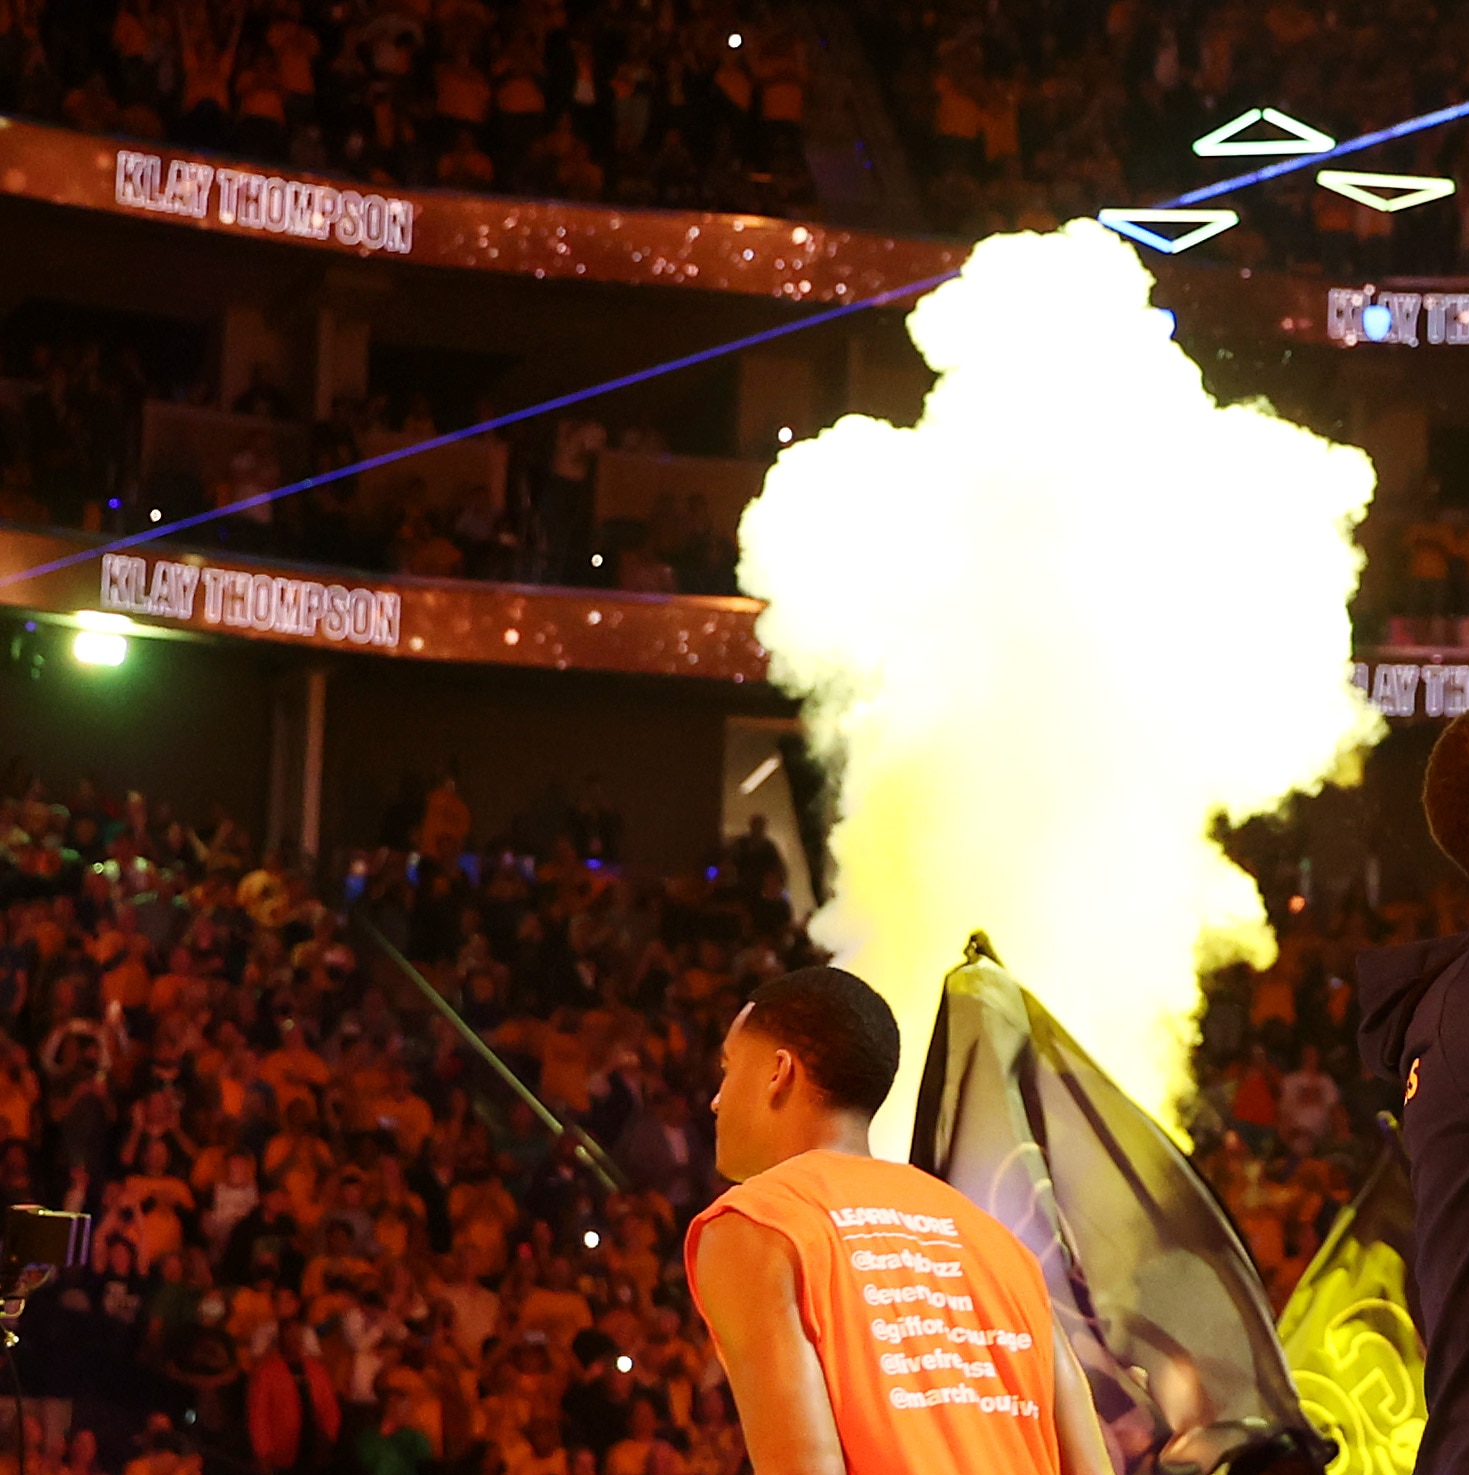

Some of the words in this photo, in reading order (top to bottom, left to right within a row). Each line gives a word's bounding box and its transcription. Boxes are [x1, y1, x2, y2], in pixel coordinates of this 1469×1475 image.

[115, 149, 214, 219] KLAY
[215, 167, 414, 254] THOMPSON
[101, 552, 200, 620] KLAY
[201, 567, 401, 648] THOMPSON
[829, 1206, 899, 1228] LEARN
